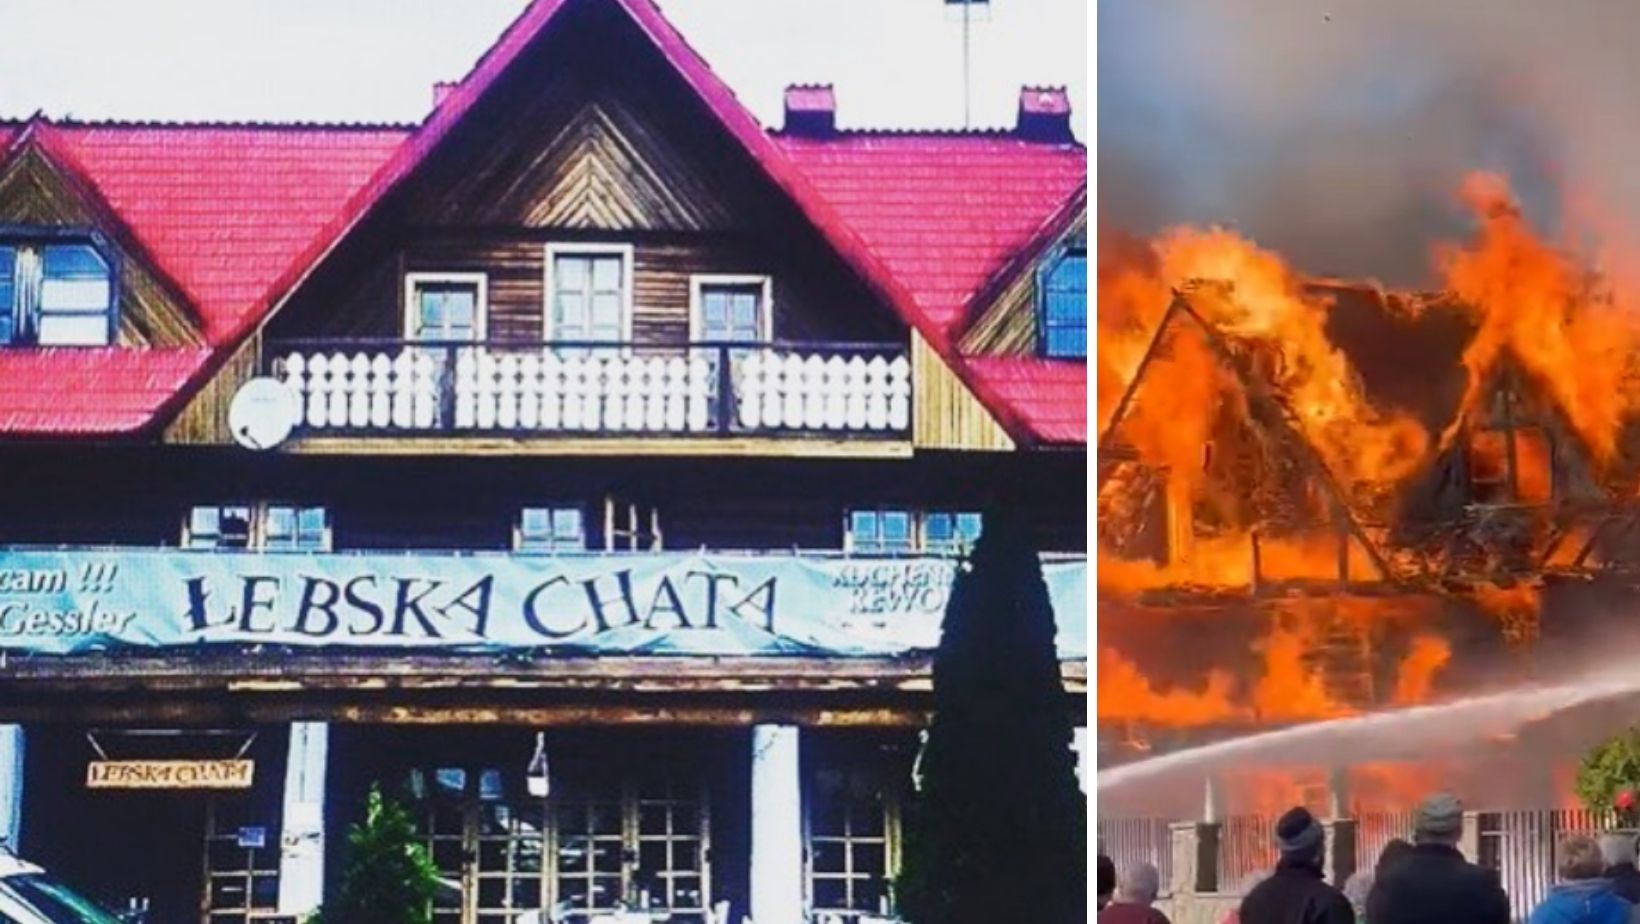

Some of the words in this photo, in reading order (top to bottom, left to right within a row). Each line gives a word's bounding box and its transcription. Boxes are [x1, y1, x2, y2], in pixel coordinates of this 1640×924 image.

[79, 562, 119, 592] !!!
[0, 599, 137, 637] Gessler
[181, 573, 495, 639] ŁEBSKA
[522, 568, 780, 639] CHATA
